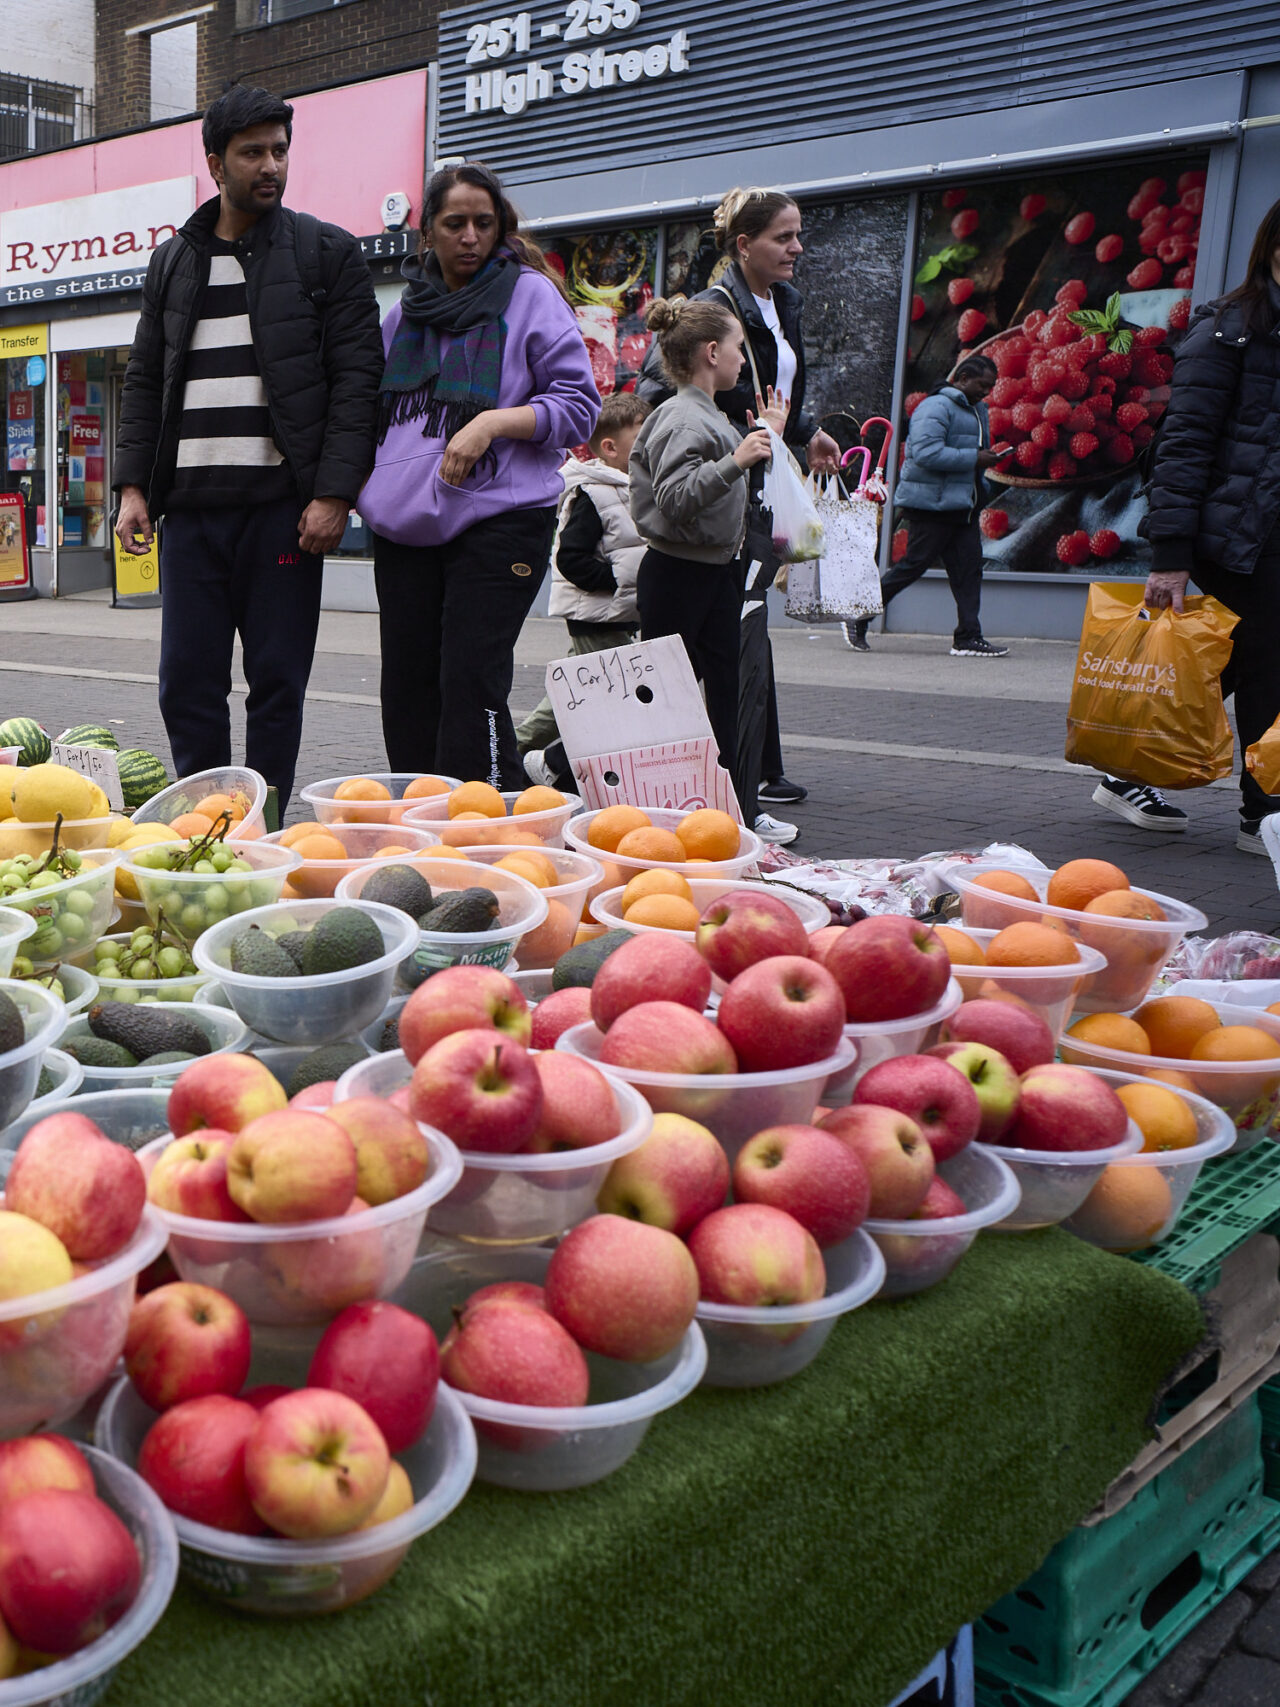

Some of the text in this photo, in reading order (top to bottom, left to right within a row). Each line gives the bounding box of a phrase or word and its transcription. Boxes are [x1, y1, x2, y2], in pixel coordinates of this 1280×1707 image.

[466, 0, 641, 64] 251 - 255
[465, 29, 691, 115] High Street
[6, 224, 179, 274] Ryman
[6, 272, 147, 303] the station
[1, 335, 39, 348] Transfer
[73, 424, 99, 438] Free
[577, 667, 601, 686] for
[1081, 651, 1176, 682] Sainsbury's
[1130, 683, 1145, 692] all
[1145, 684, 1158, 694] of
[1160, 688, 1175, 696] us
